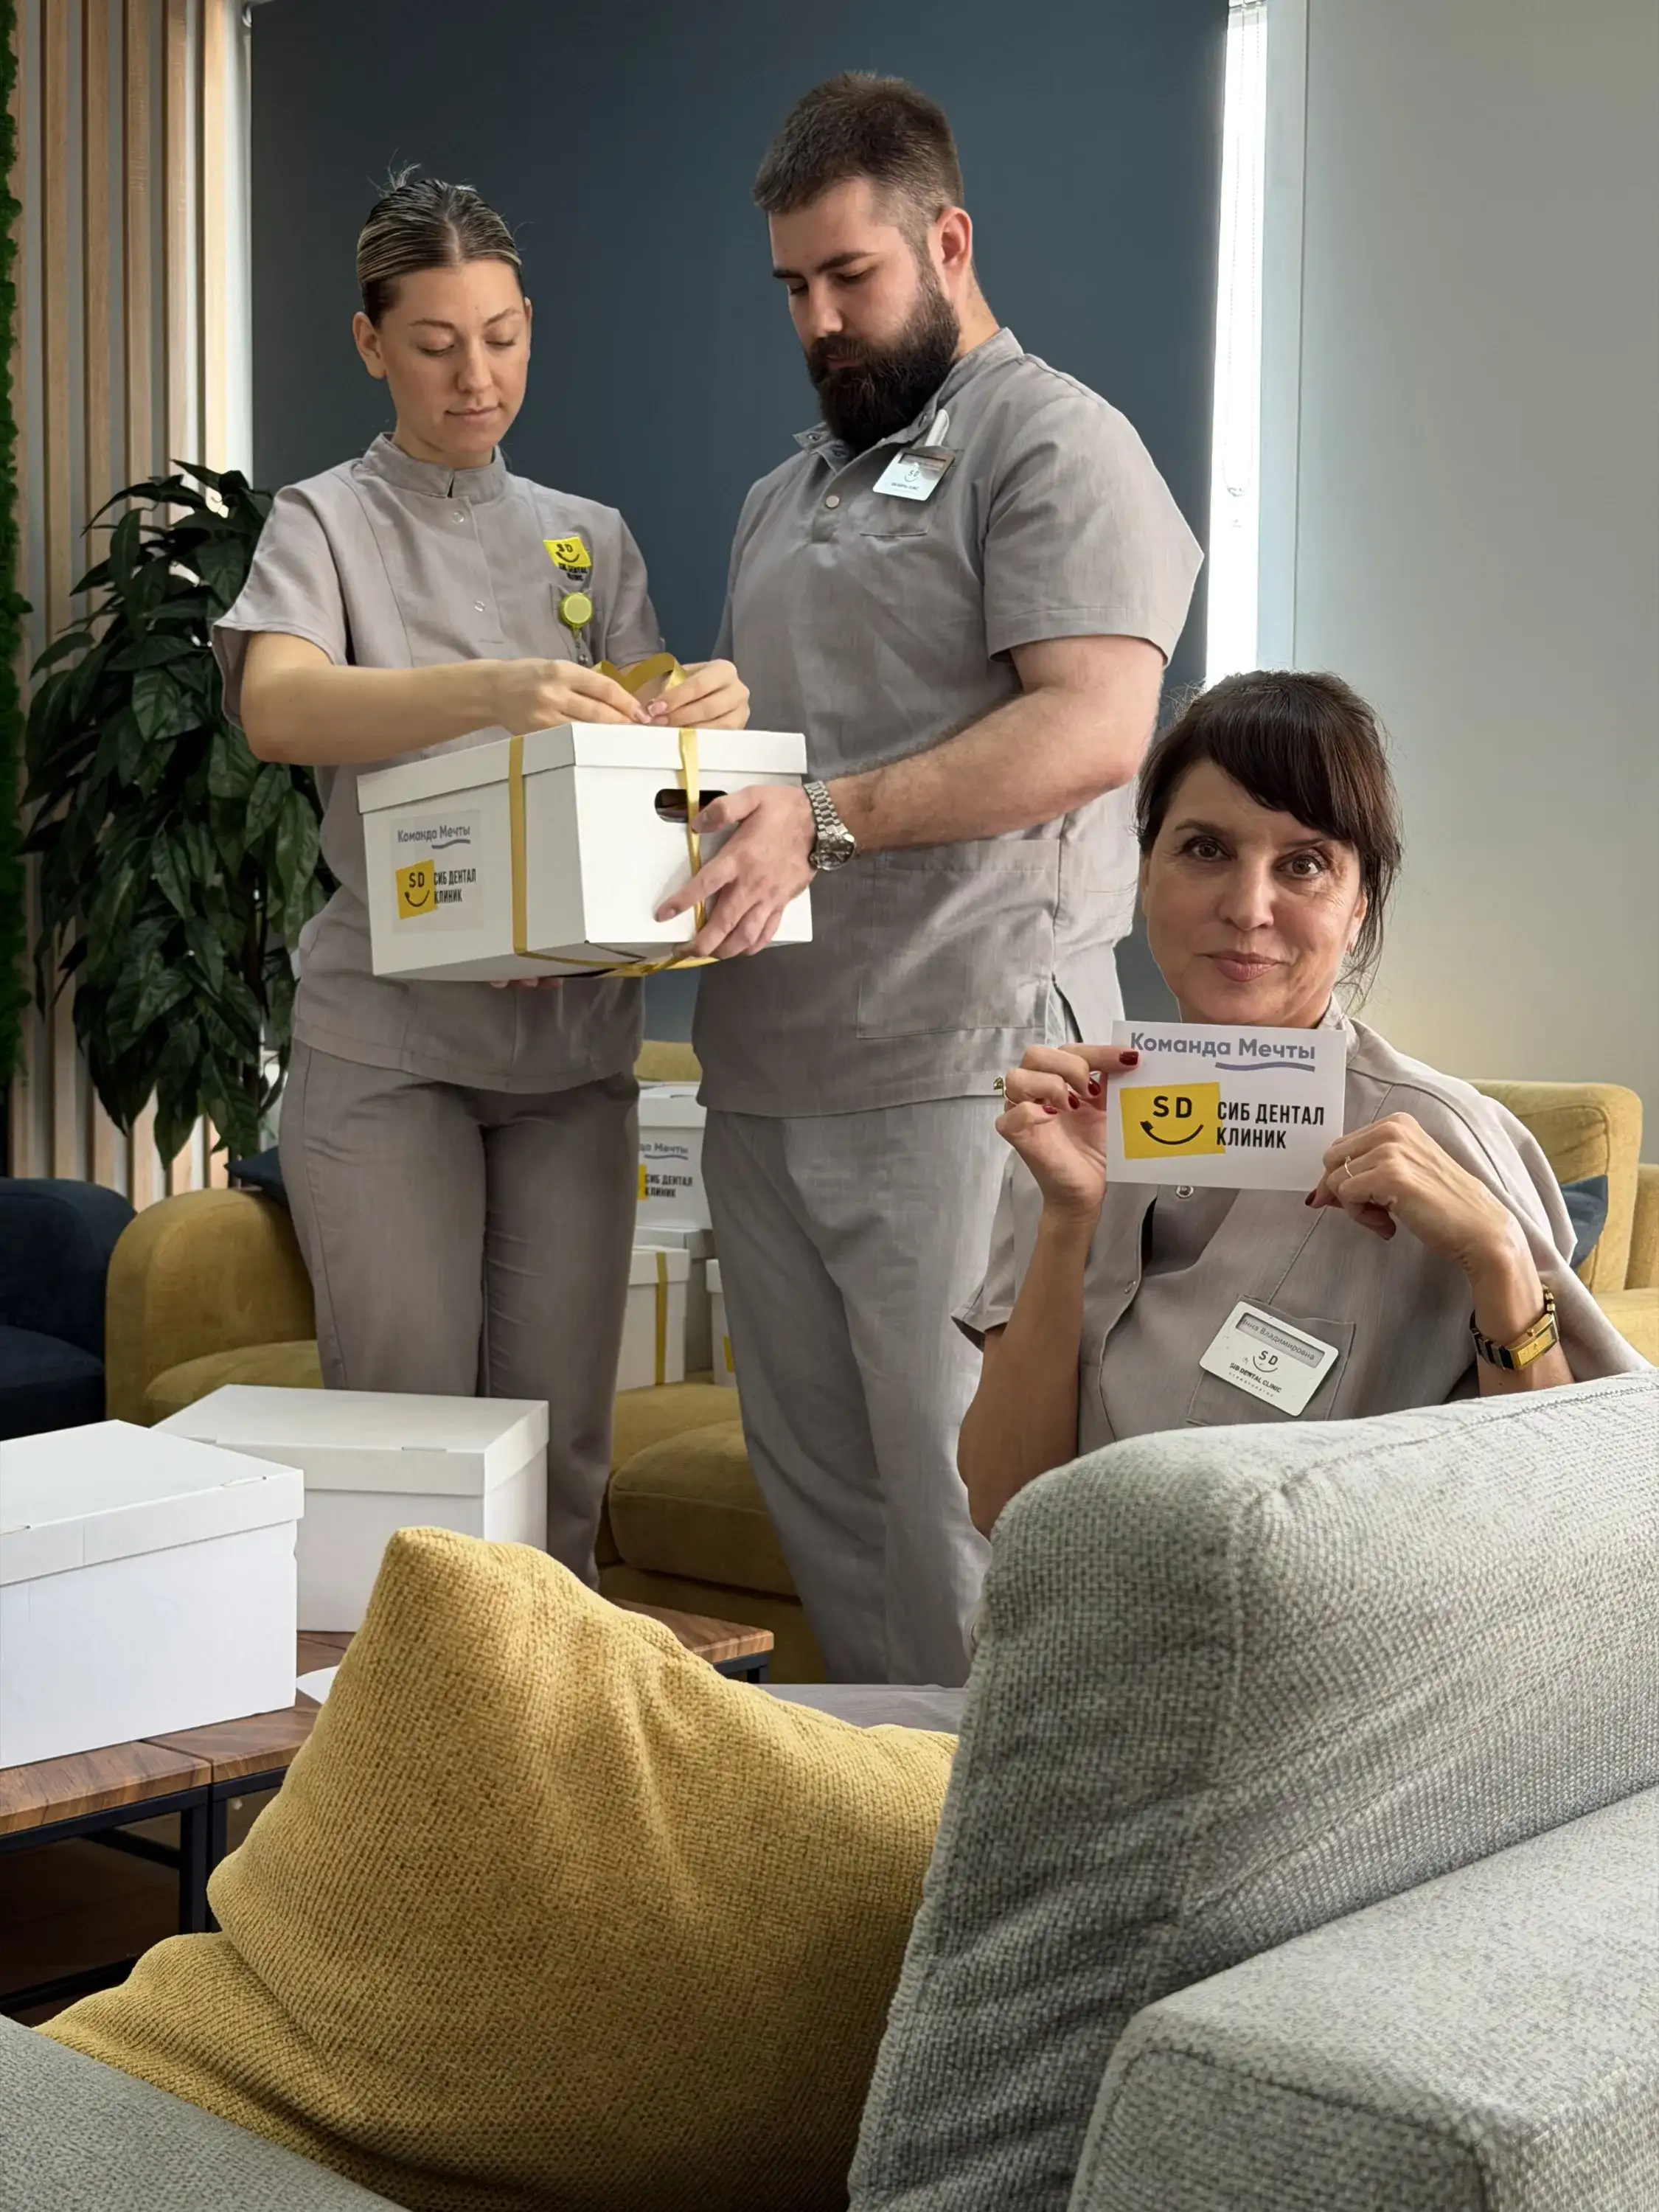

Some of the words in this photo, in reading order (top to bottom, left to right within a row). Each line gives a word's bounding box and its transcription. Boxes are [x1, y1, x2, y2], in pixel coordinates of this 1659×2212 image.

[397, 830, 437, 843] Команда
[439, 825, 470, 838] Мечты
[434, 871, 447, 885] СИБ
[448, 869, 476, 886] ДЕНТАЛ
[434, 888, 462, 904] КЛИНИК
[1130, 1032, 1231, 1057] Команда
[1239, 1038, 1315, 1060] Мечты
[1217, 1102, 1250, 1121] СИБ
[1256, 1104, 1324, 1125] ДЕНТАЛ
[1217, 1127, 1287, 1149] КЛИНИК
[661, 1175, 693, 1186] ДЕНТАЛ
[645, 1186, 676, 1198] КЛИНИК
[1259, 1327, 1315, 1360] Владимировна
[1229, 1363, 1240, 1371] SIB
[1239, 1367, 1262, 1384] DENTAL
[1262, 1380, 1282, 1394] CLINIC
